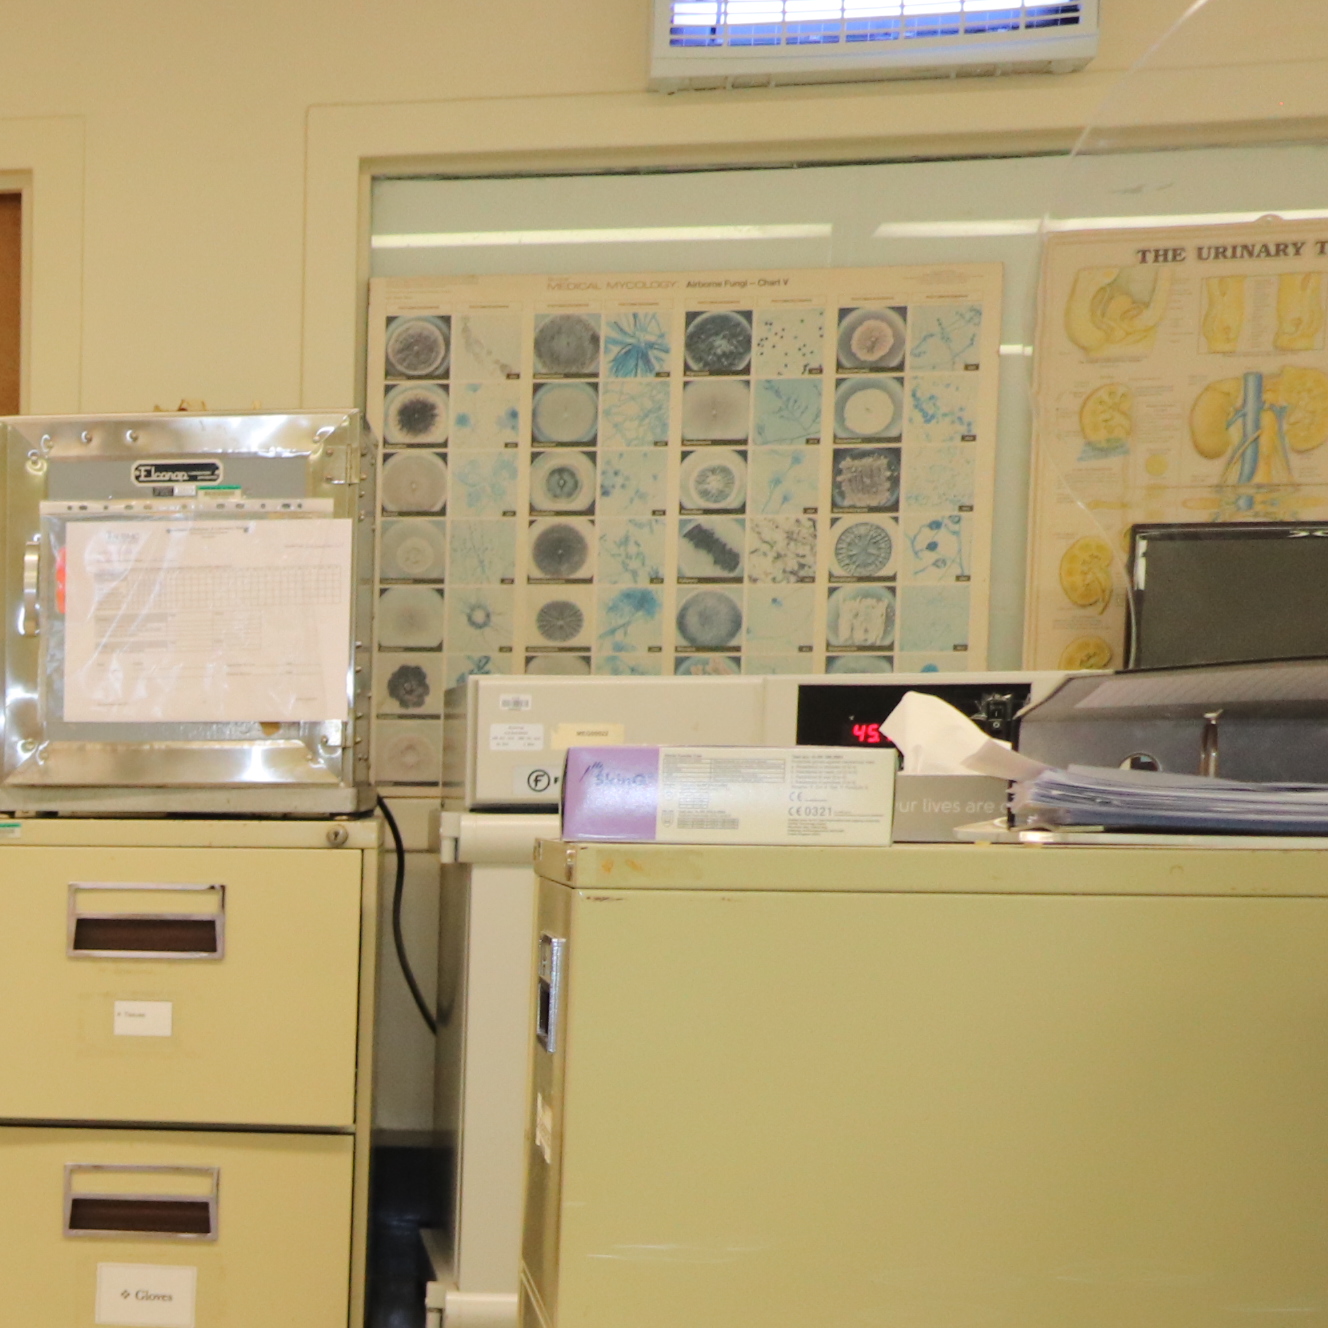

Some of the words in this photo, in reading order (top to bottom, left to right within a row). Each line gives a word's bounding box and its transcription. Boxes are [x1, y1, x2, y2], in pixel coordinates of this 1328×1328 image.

[1137, 246, 1186, 265] THE
[1196, 241, 1306, 261] URINARY
[547, 280, 601, 291] MEDICAL
[607, 280, 677, 290] MYCOLOGY
[686, 278, 722, 289] Airborne
[724, 278, 748, 289] Fungi
[758, 277, 781, 288] Chart
[783, 277, 789, 287] V
[852, 724, 890, 743] 45
[804, 806, 832, 817] 0321
[923, 797, 961, 813] lives
[965, 801, 995, 813] are
[135, 1289, 173, 1301] Gloves
